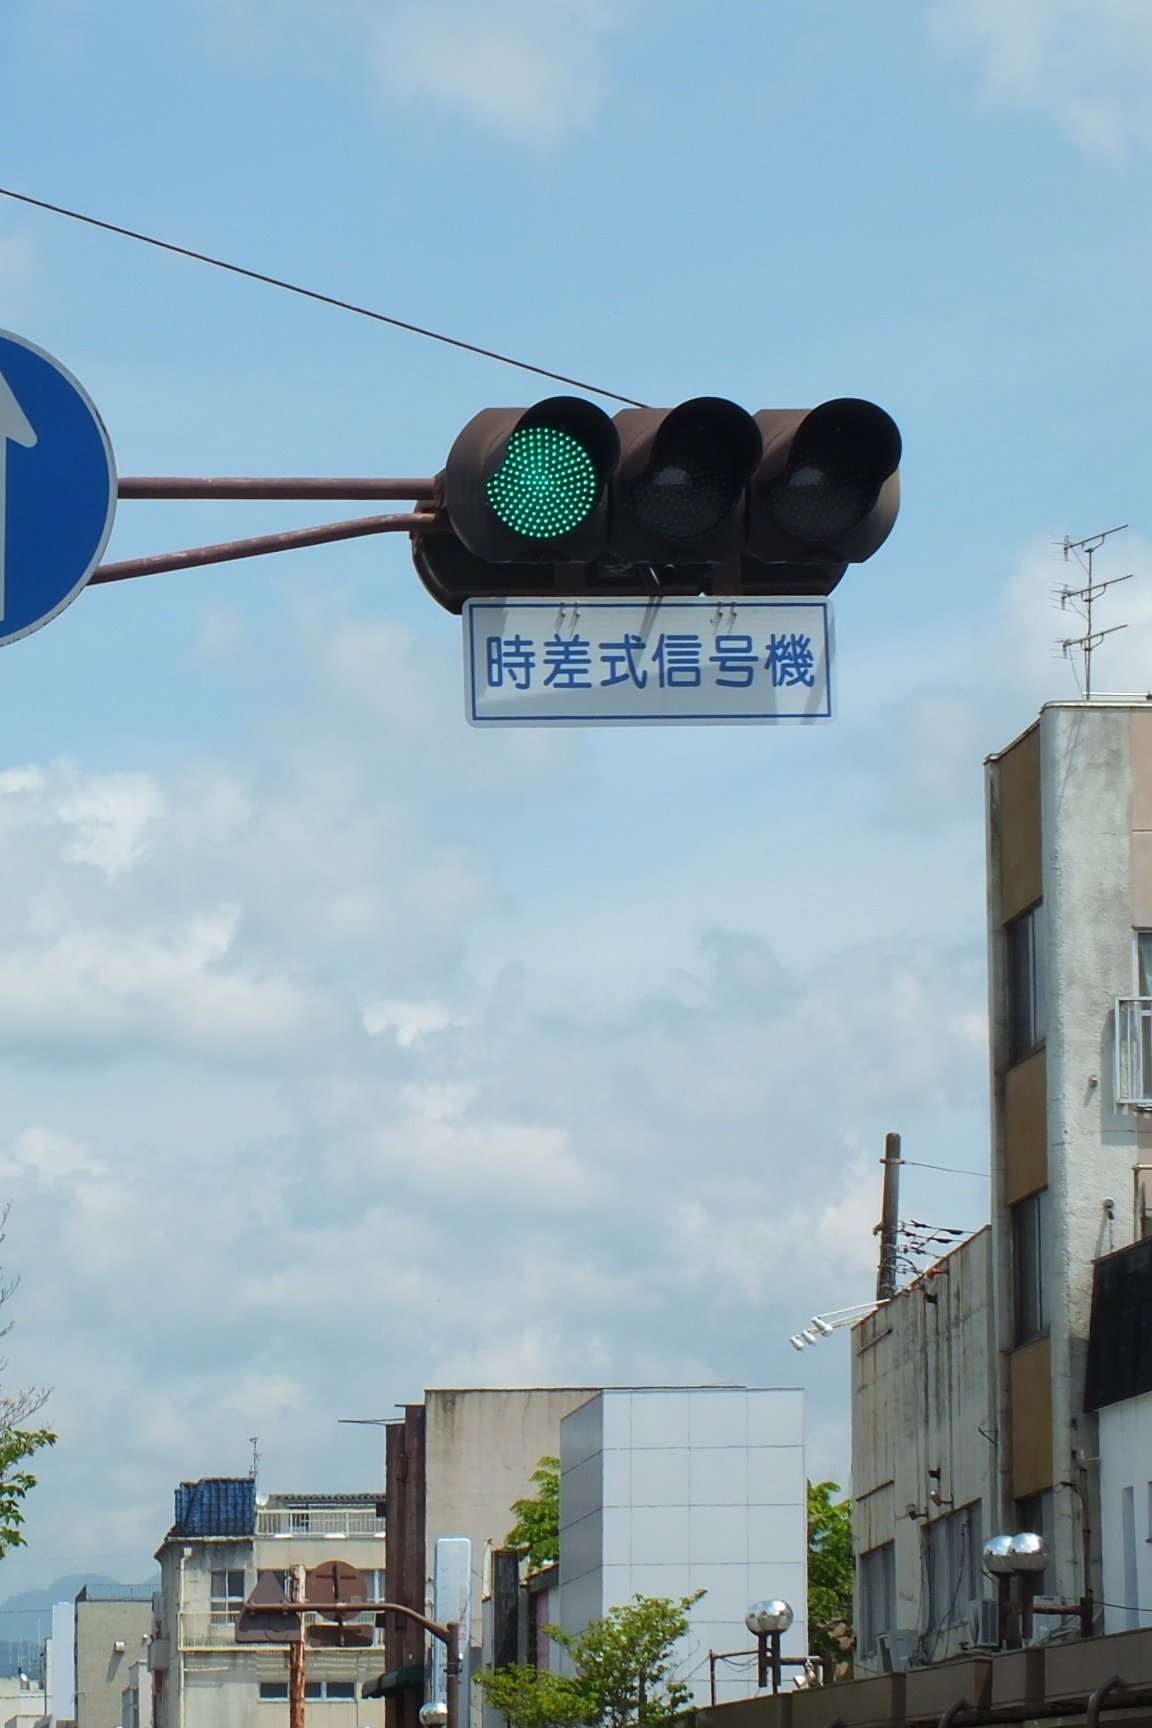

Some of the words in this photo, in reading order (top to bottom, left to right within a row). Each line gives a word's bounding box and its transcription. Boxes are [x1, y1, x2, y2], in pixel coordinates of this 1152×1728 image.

[485, 632, 816, 690] 時差式信号機
